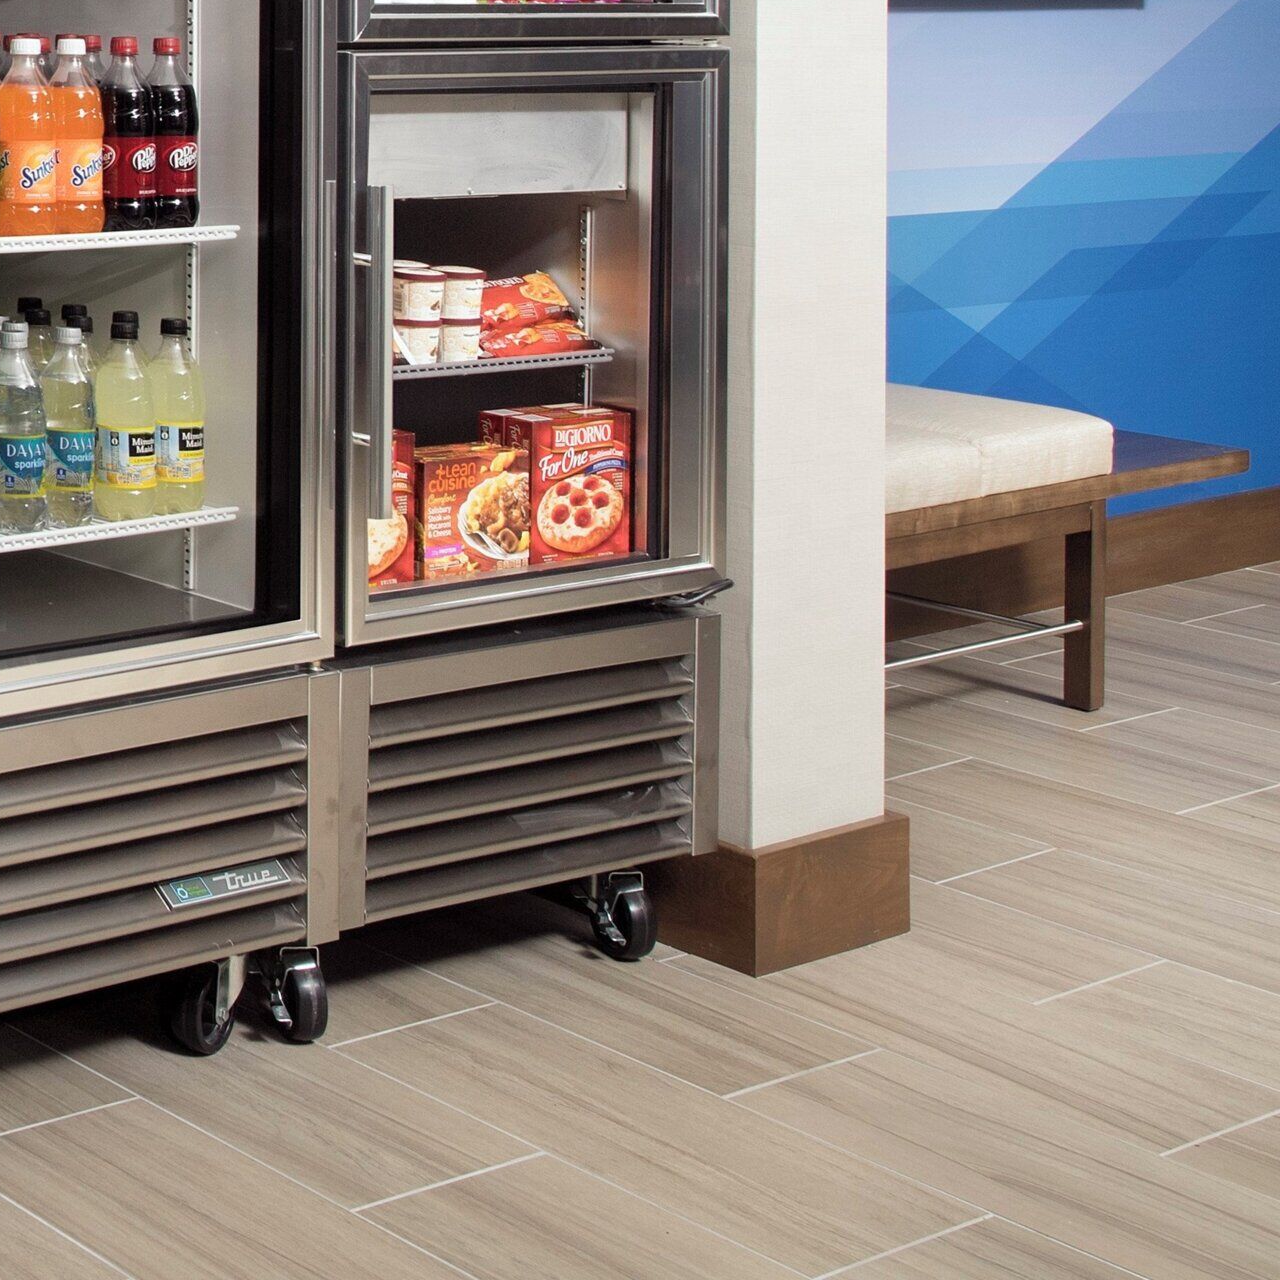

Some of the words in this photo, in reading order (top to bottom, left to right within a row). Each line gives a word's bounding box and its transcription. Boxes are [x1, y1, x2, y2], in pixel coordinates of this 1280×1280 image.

[183, 145, 194, 156] Dr
[186, 439, 203, 448] Maid
[538, 453, 562, 482] For
[561, 446, 589, 473] One
